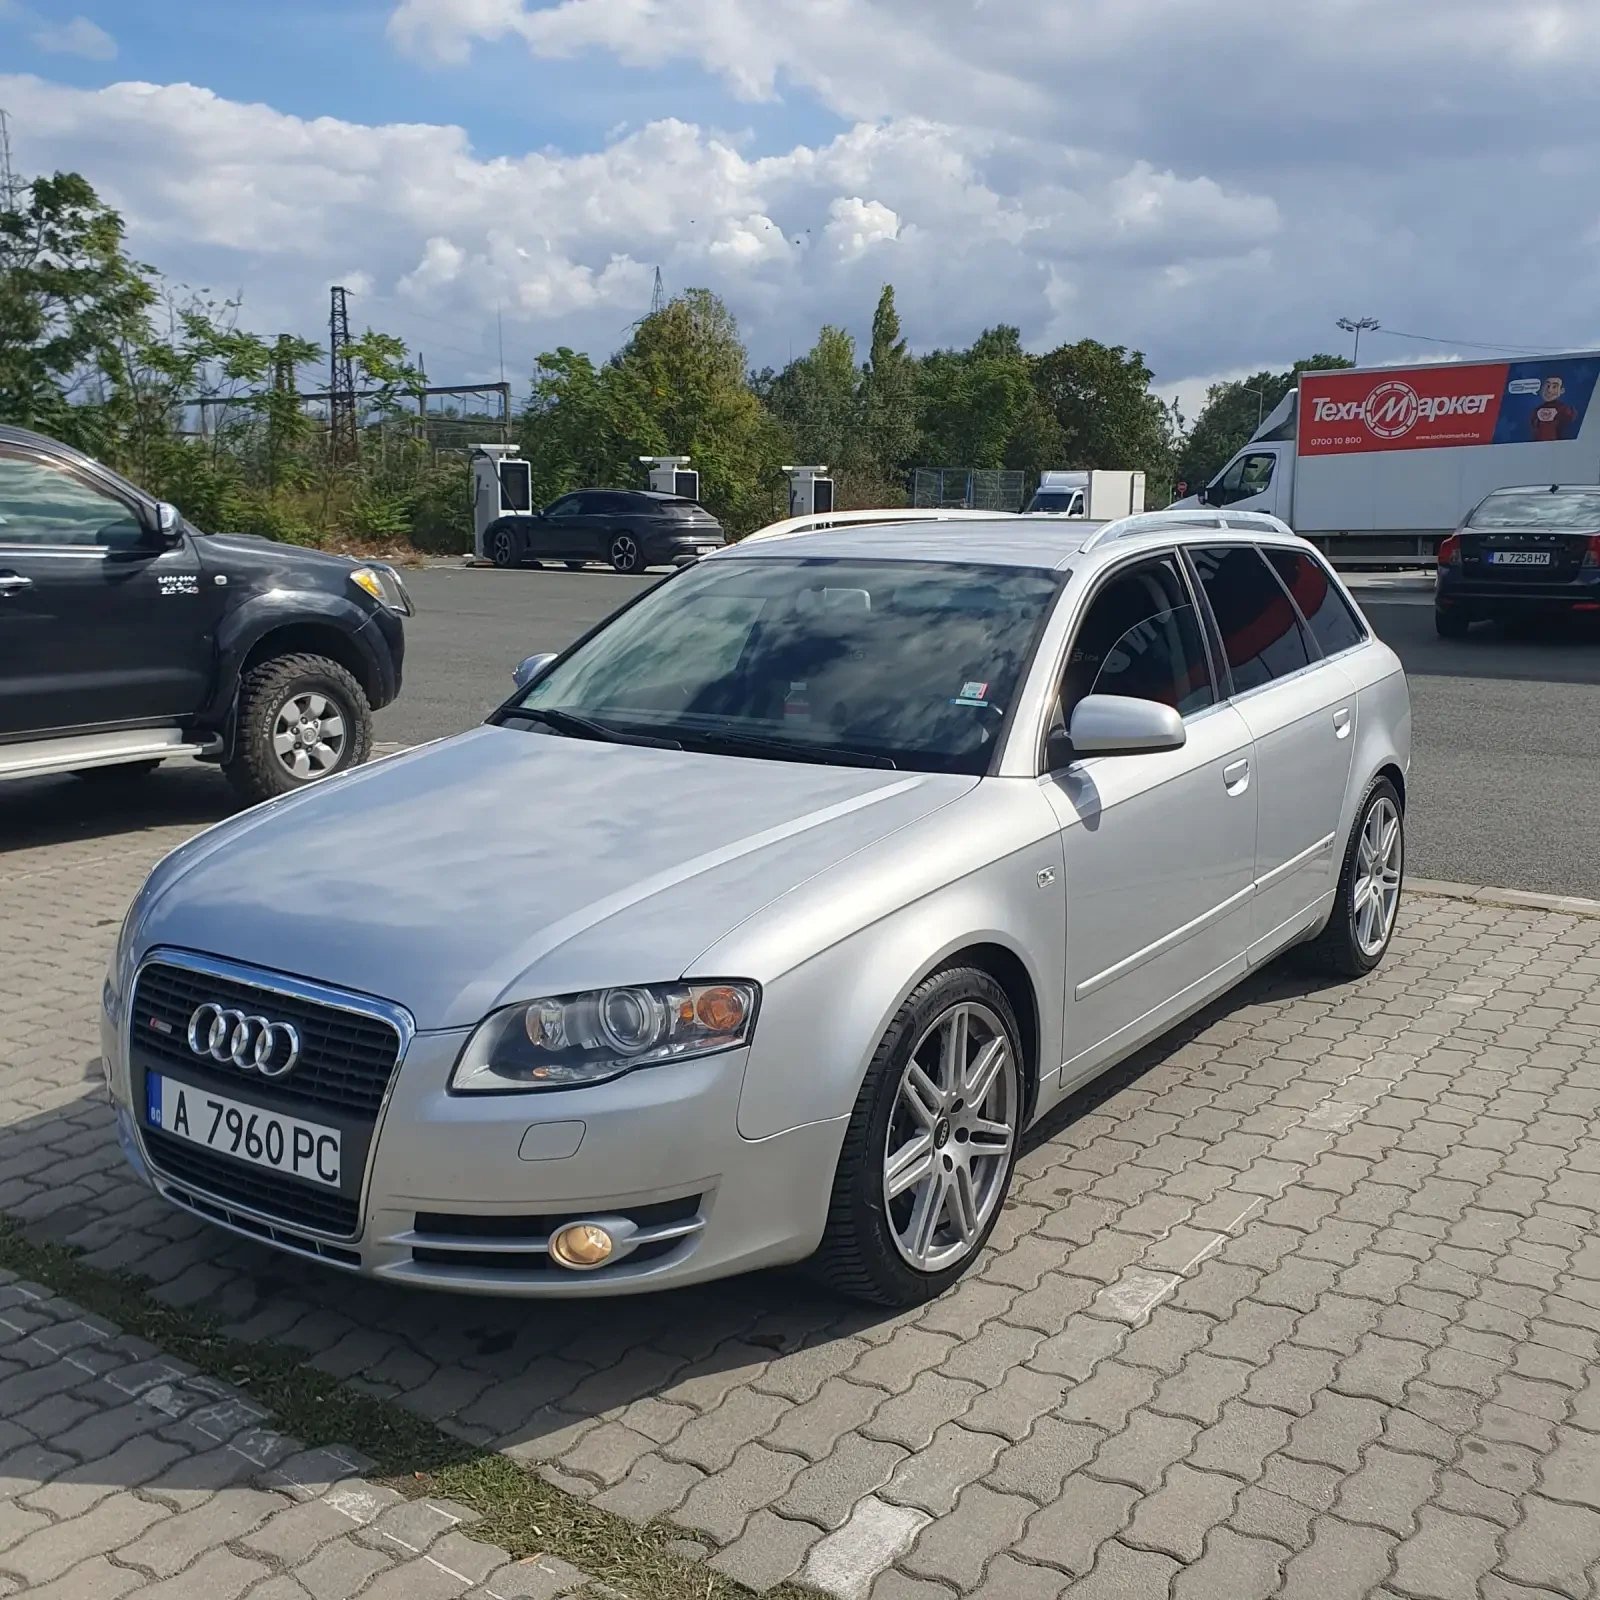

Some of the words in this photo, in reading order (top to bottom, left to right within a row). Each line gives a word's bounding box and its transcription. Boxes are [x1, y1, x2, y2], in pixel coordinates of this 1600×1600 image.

[1345, 436, 1362, 444] 800
[262, 685, 290, 740] AUSTONE
[173, 1090, 190, 1136] A
[206, 1100, 284, 1165] 7960
[292, 1126, 339, 1182] PC
